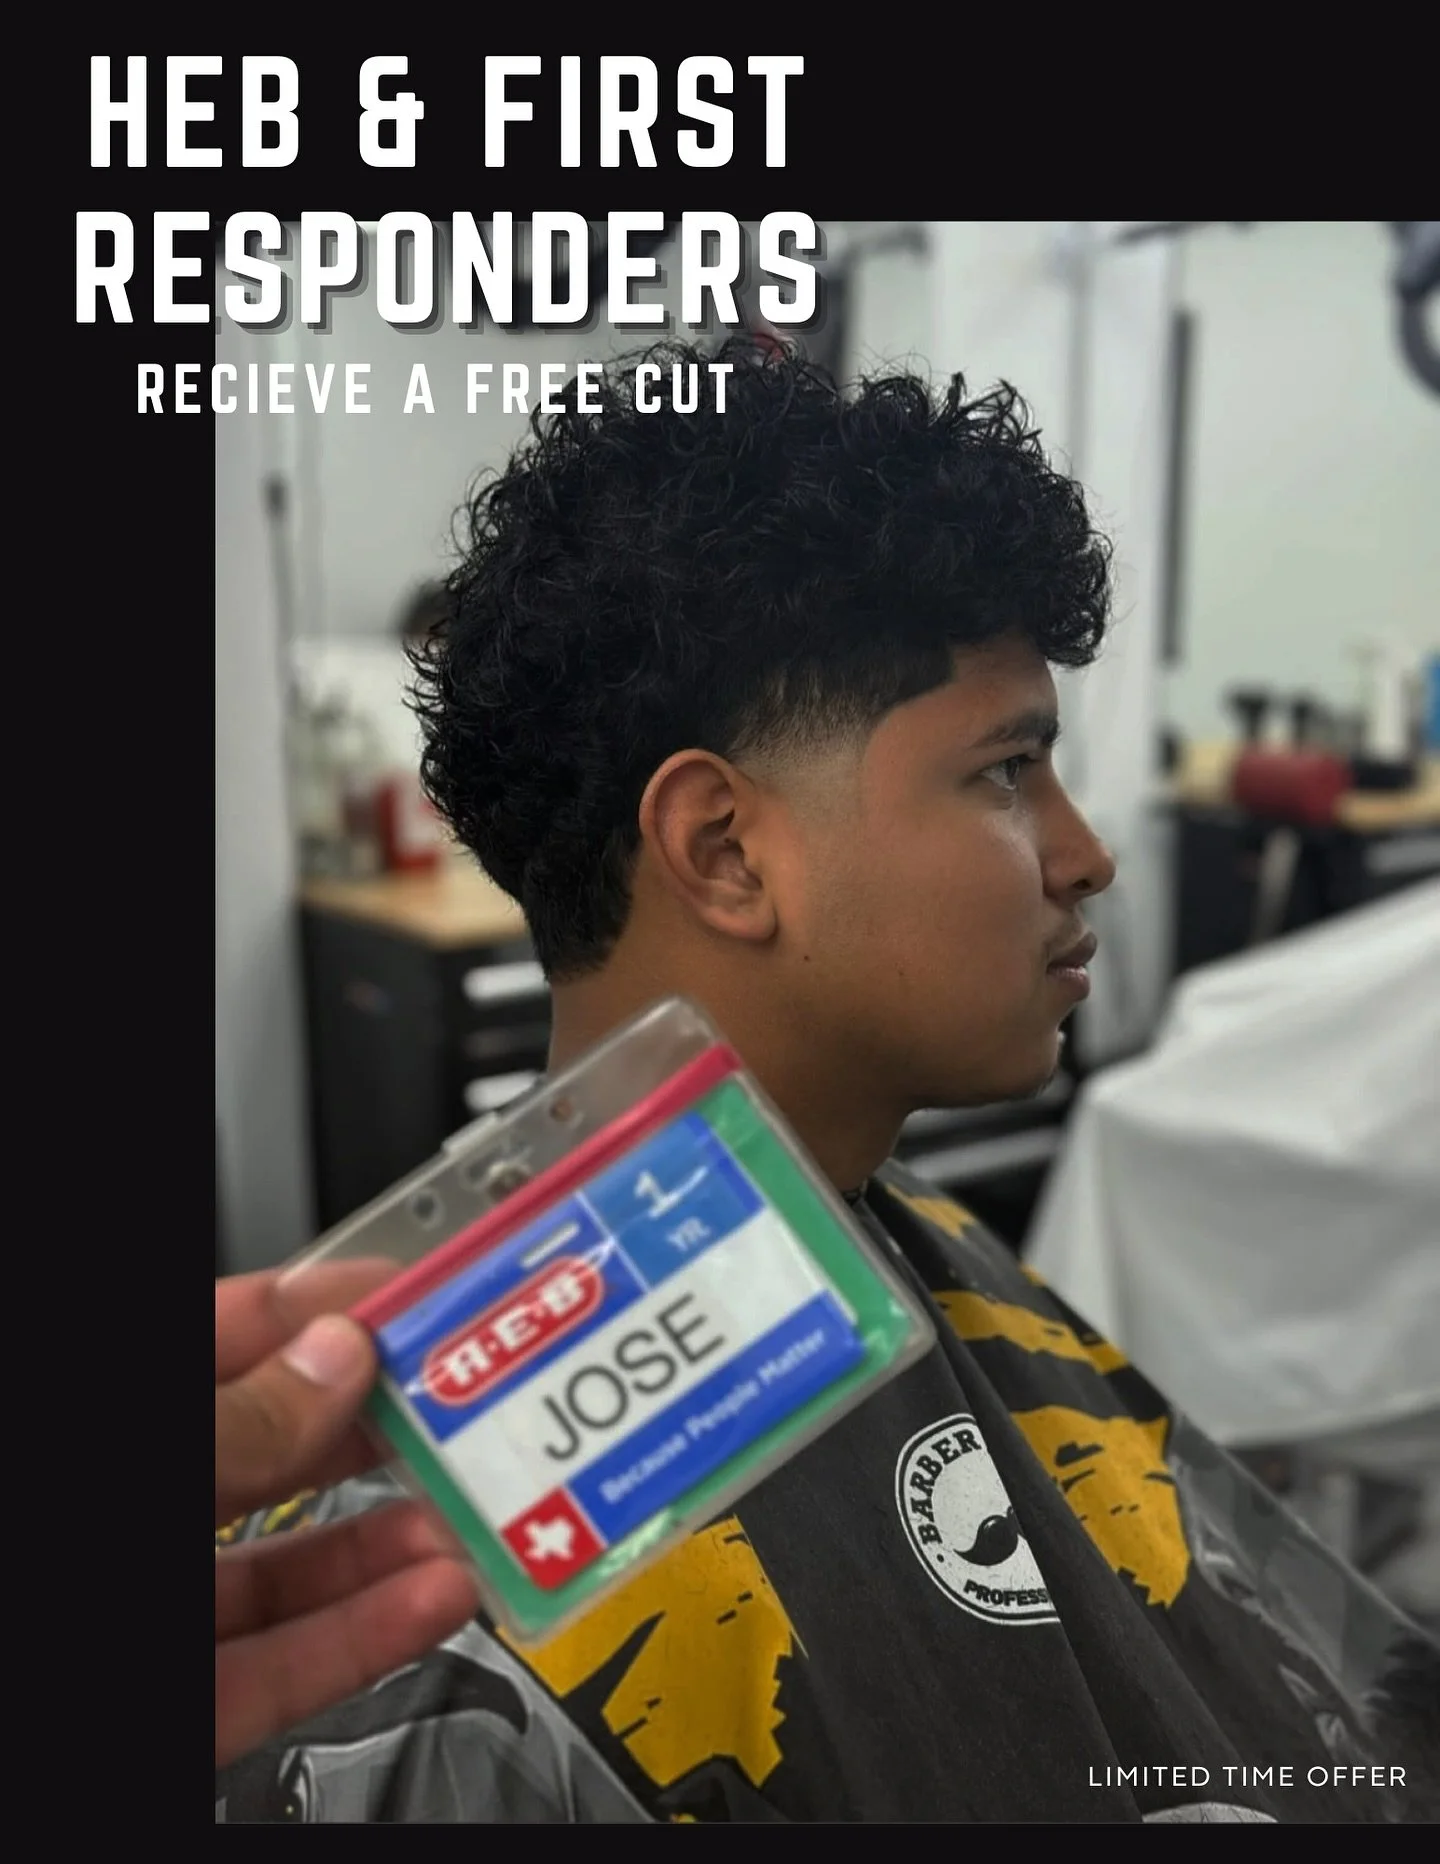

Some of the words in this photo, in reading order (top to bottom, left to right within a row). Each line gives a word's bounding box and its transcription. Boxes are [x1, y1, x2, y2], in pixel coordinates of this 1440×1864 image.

[541, 1292, 725, 1462] JOSE
[600, 1432, 688, 1504] Because
[684, 1378, 760, 1440] People
[757, 1326, 825, 1386] Matter
[910, 1428, 982, 1546] BARBER
